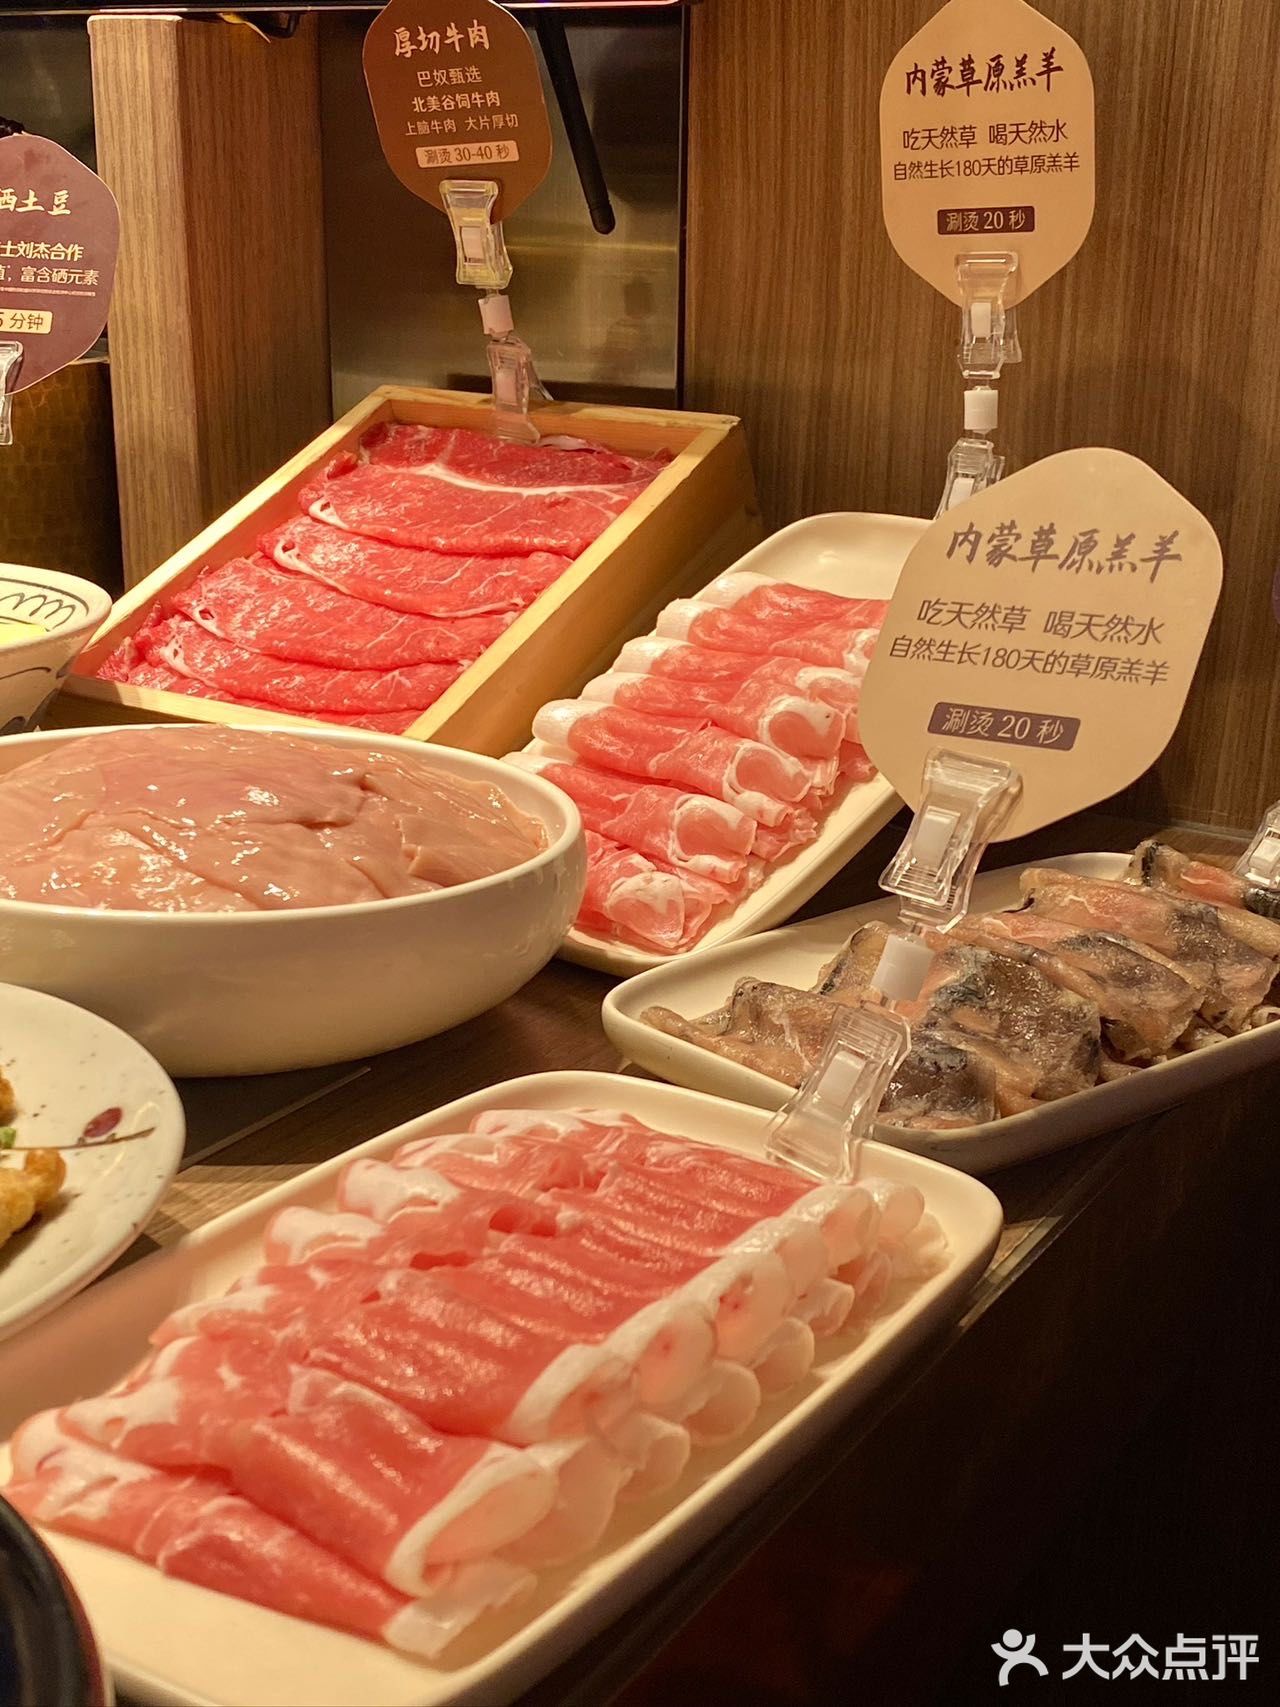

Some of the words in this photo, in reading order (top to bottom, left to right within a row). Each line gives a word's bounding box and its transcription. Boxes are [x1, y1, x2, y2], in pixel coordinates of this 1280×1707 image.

[394, 19, 490, 58] 厚切牛肉
[416, 65, 483, 88] 巴奴甄选
[905, 46, 1064, 97] 内蒙草原羔羊
[411, 91, 501, 113] 北美谷饲牛肉
[404, 118, 457, 136] 上脑牛肉
[464, 113, 519, 132] 大片厚切
[902, 125, 978, 151] 吃天然草
[988, 118, 1068, 146] 喝天然水
[424, 148, 452, 165] 涮烫
[454, 145, 493, 162] 30-40
[496, 144, 510, 160] 秒
[893, 151, 1080, 181] 自然生长180天的草原羔羊
[946, 211, 980, 232] 涮烫
[983, 210, 1004, 230] 20
[1008, 208, 1026, 231] 秒
[0, 240, 84, 262] 士刘杰合作
[10, 312, 44, 331] 分钟
[945, 519, 1184, 584] 内蒙草原羔羊
[916, 597, 1031, 634] 吃天然草
[1042, 609, 1165, 646] 喝天然水
[889, 635, 1171, 687] 自然生长180天的草原羔羊
[942, 707, 994, 737] 涮烫
[997, 714, 1031, 740] 20
[1036, 719, 1064, 745] 秒
